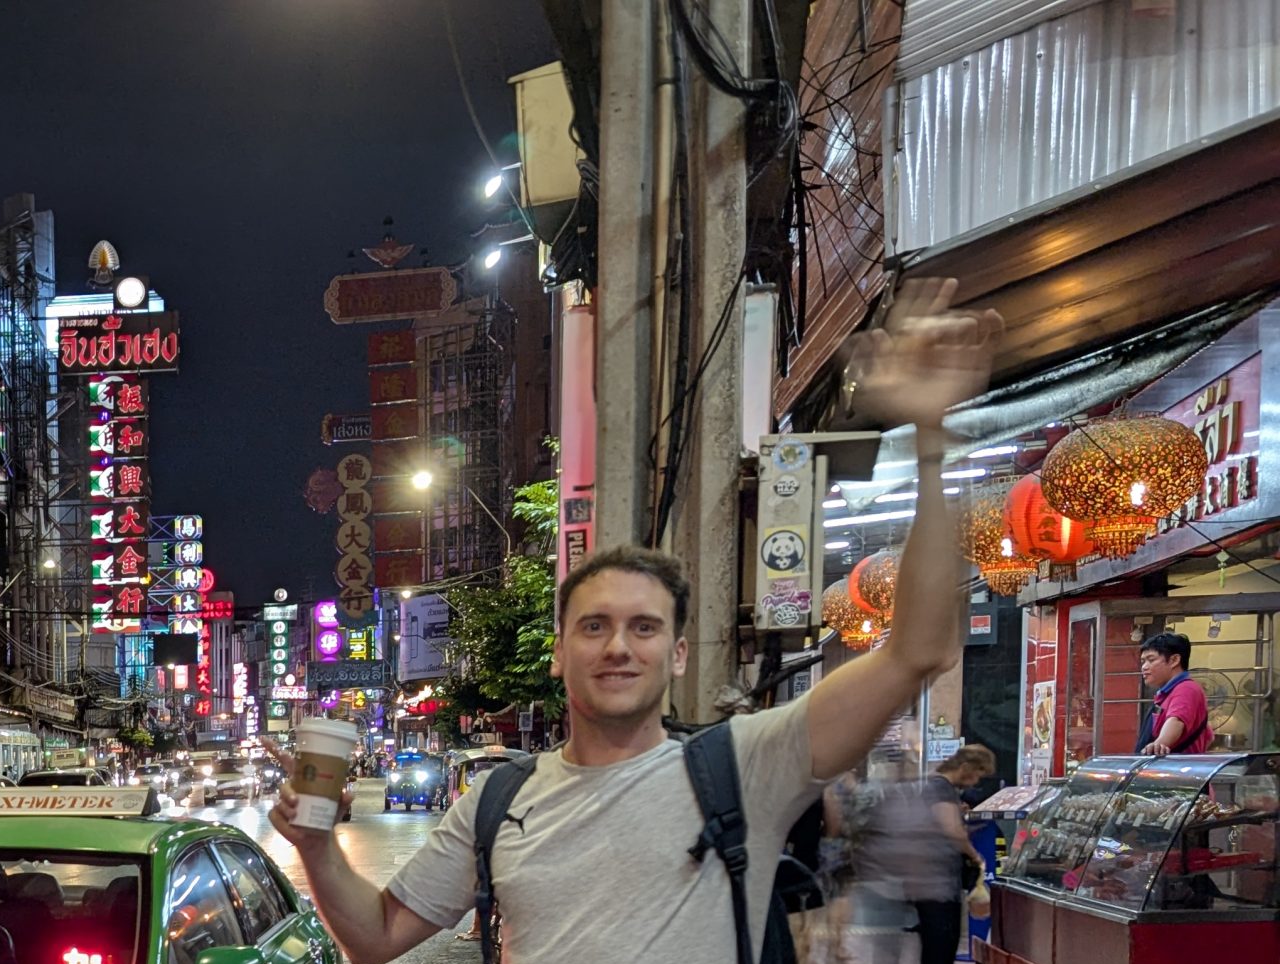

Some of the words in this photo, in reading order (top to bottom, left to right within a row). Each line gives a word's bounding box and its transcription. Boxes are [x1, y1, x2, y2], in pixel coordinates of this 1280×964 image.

[117, 383, 144, 613] 振和興大金行
[343, 458, 367, 611] 龍鳳大金行
